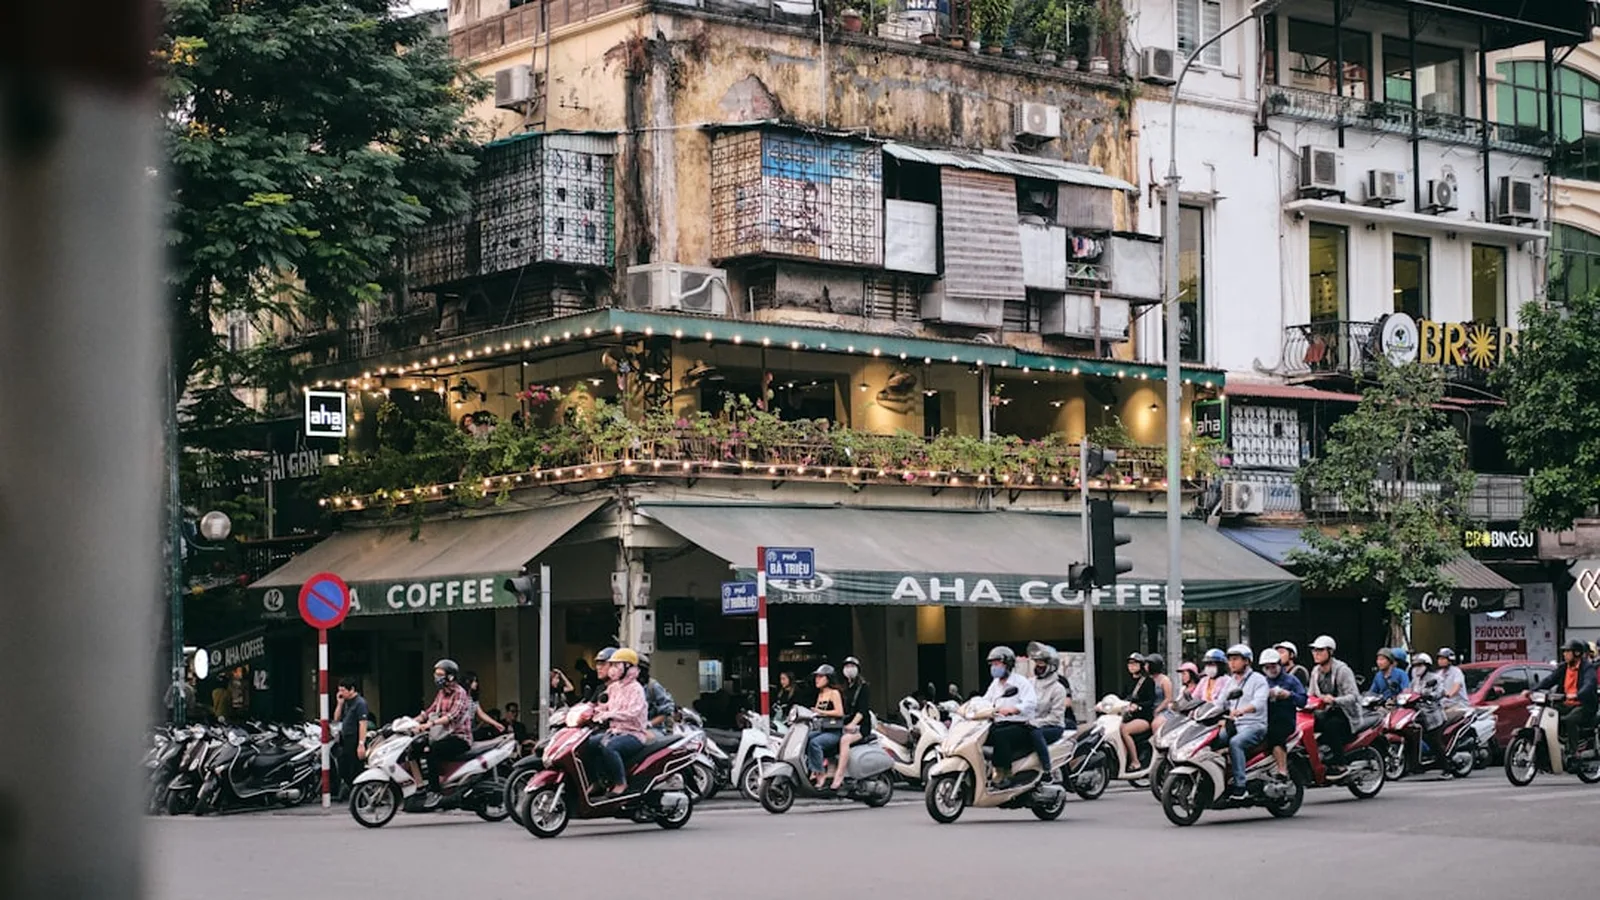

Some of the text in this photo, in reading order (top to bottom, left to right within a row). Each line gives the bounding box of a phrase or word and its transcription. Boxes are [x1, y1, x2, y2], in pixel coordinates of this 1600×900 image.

[311, 403, 341, 425] aha
[1197, 413, 1220, 434] aha
[770, 560, 810, 577] BÀ TRIỆU
[387, 578, 495, 609] COFFEE
[891, 576, 1002, 602] AHA
[664, 614, 694, 637] aha
[1475, 626, 1527, 638] PHOTOCOPY
[225, 636, 264, 667] AHA COFFEE
